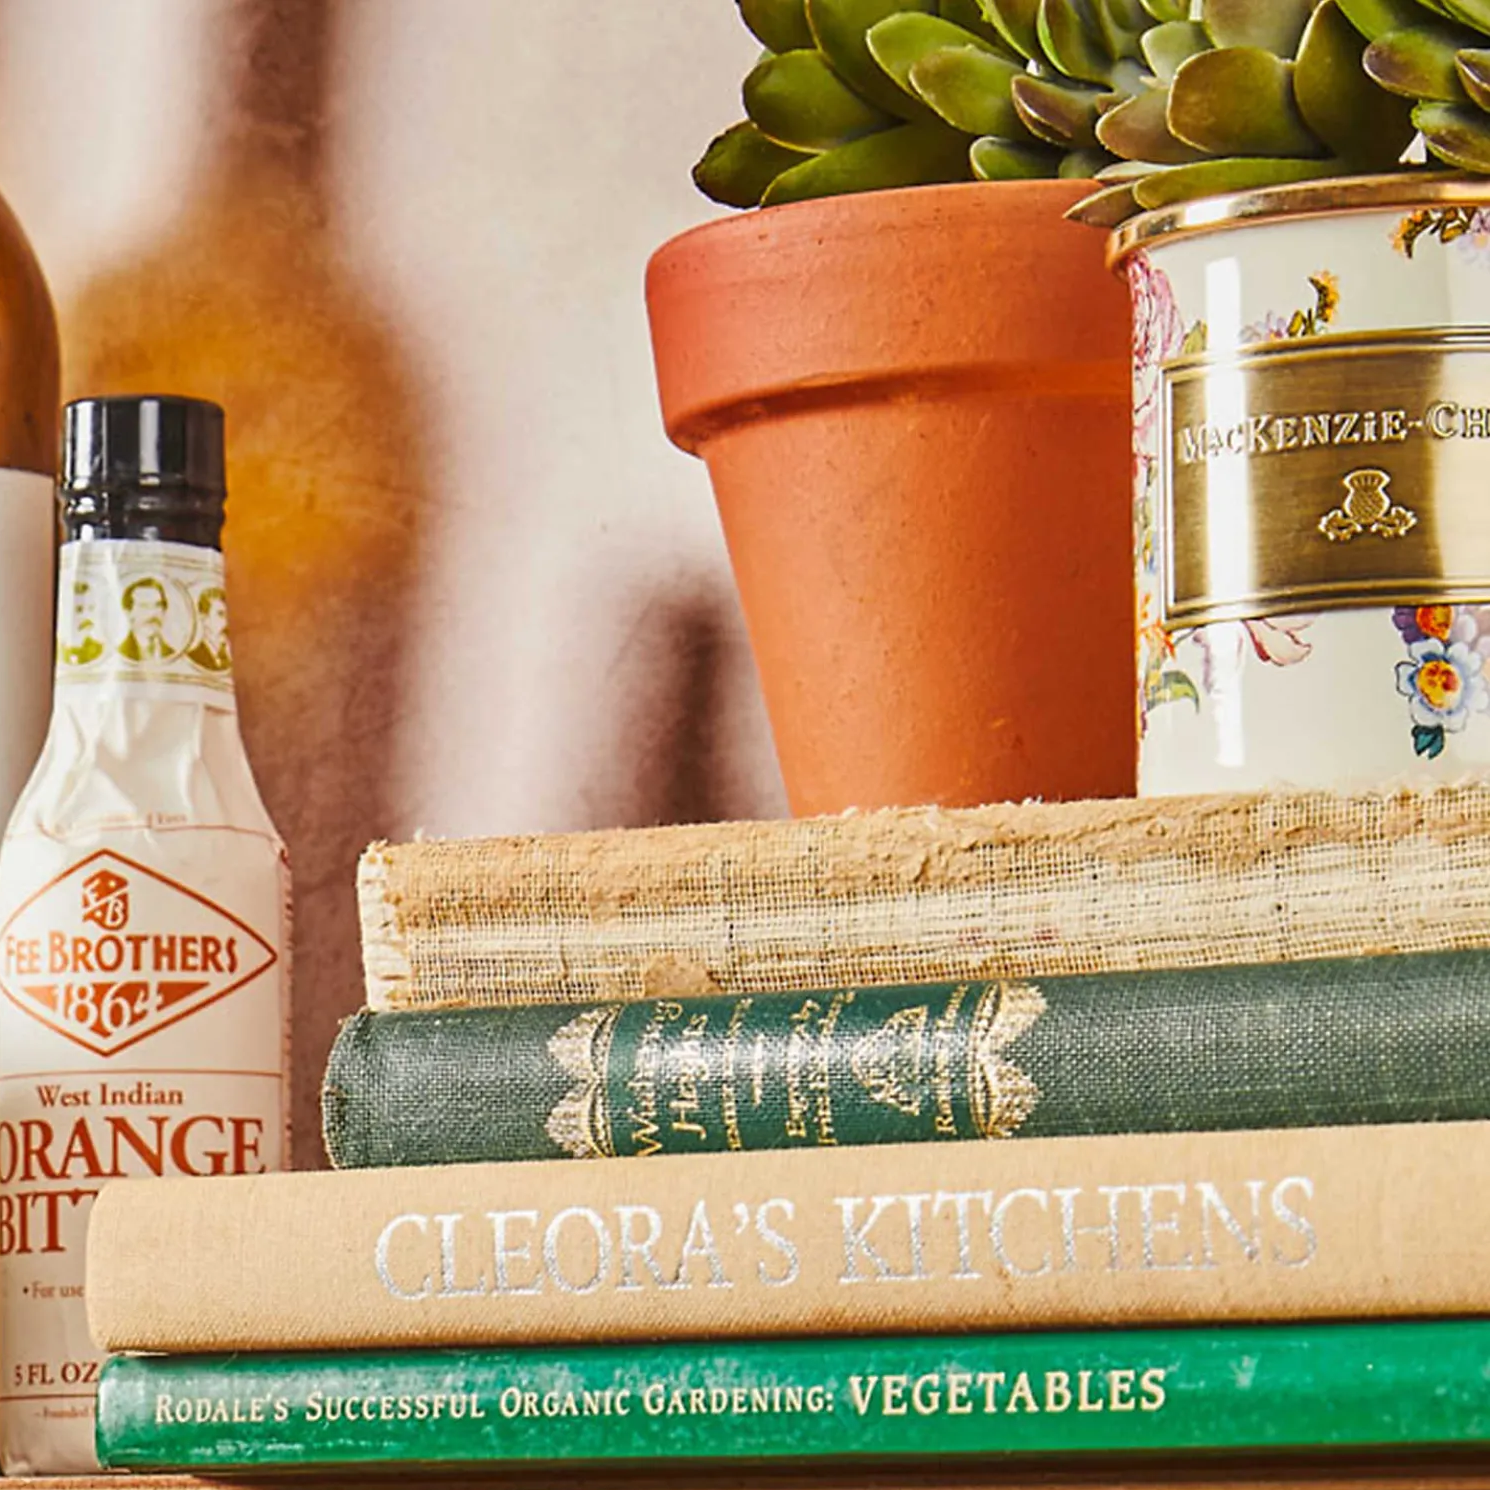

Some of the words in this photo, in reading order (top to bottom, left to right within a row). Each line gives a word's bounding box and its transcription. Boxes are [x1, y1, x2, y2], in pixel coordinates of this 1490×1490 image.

[5, 933, 42, 977] FEE
[48, 929, 239, 975] BROTHERS
[36, 1085, 90, 1107] West
[99, 1081, 184, 1106] Indian
[374, 1198, 801, 1300] CLEORA'S
[835, 1175, 1318, 1285] KITCHENS
[32, 1281, 55, 1298] For
[27, 1362, 55, 1386] FL
[60, 1360, 99, 1384] OZ
[155, 1393, 290, 1425] RODALE'S
[305, 1390, 486, 1421] SUCCESSFUL
[500, 1385, 632, 1418] ORGANIC
[643, 1383, 835, 1416] GARDENING:
[848, 1368, 1167, 1415] VEGETABLES
